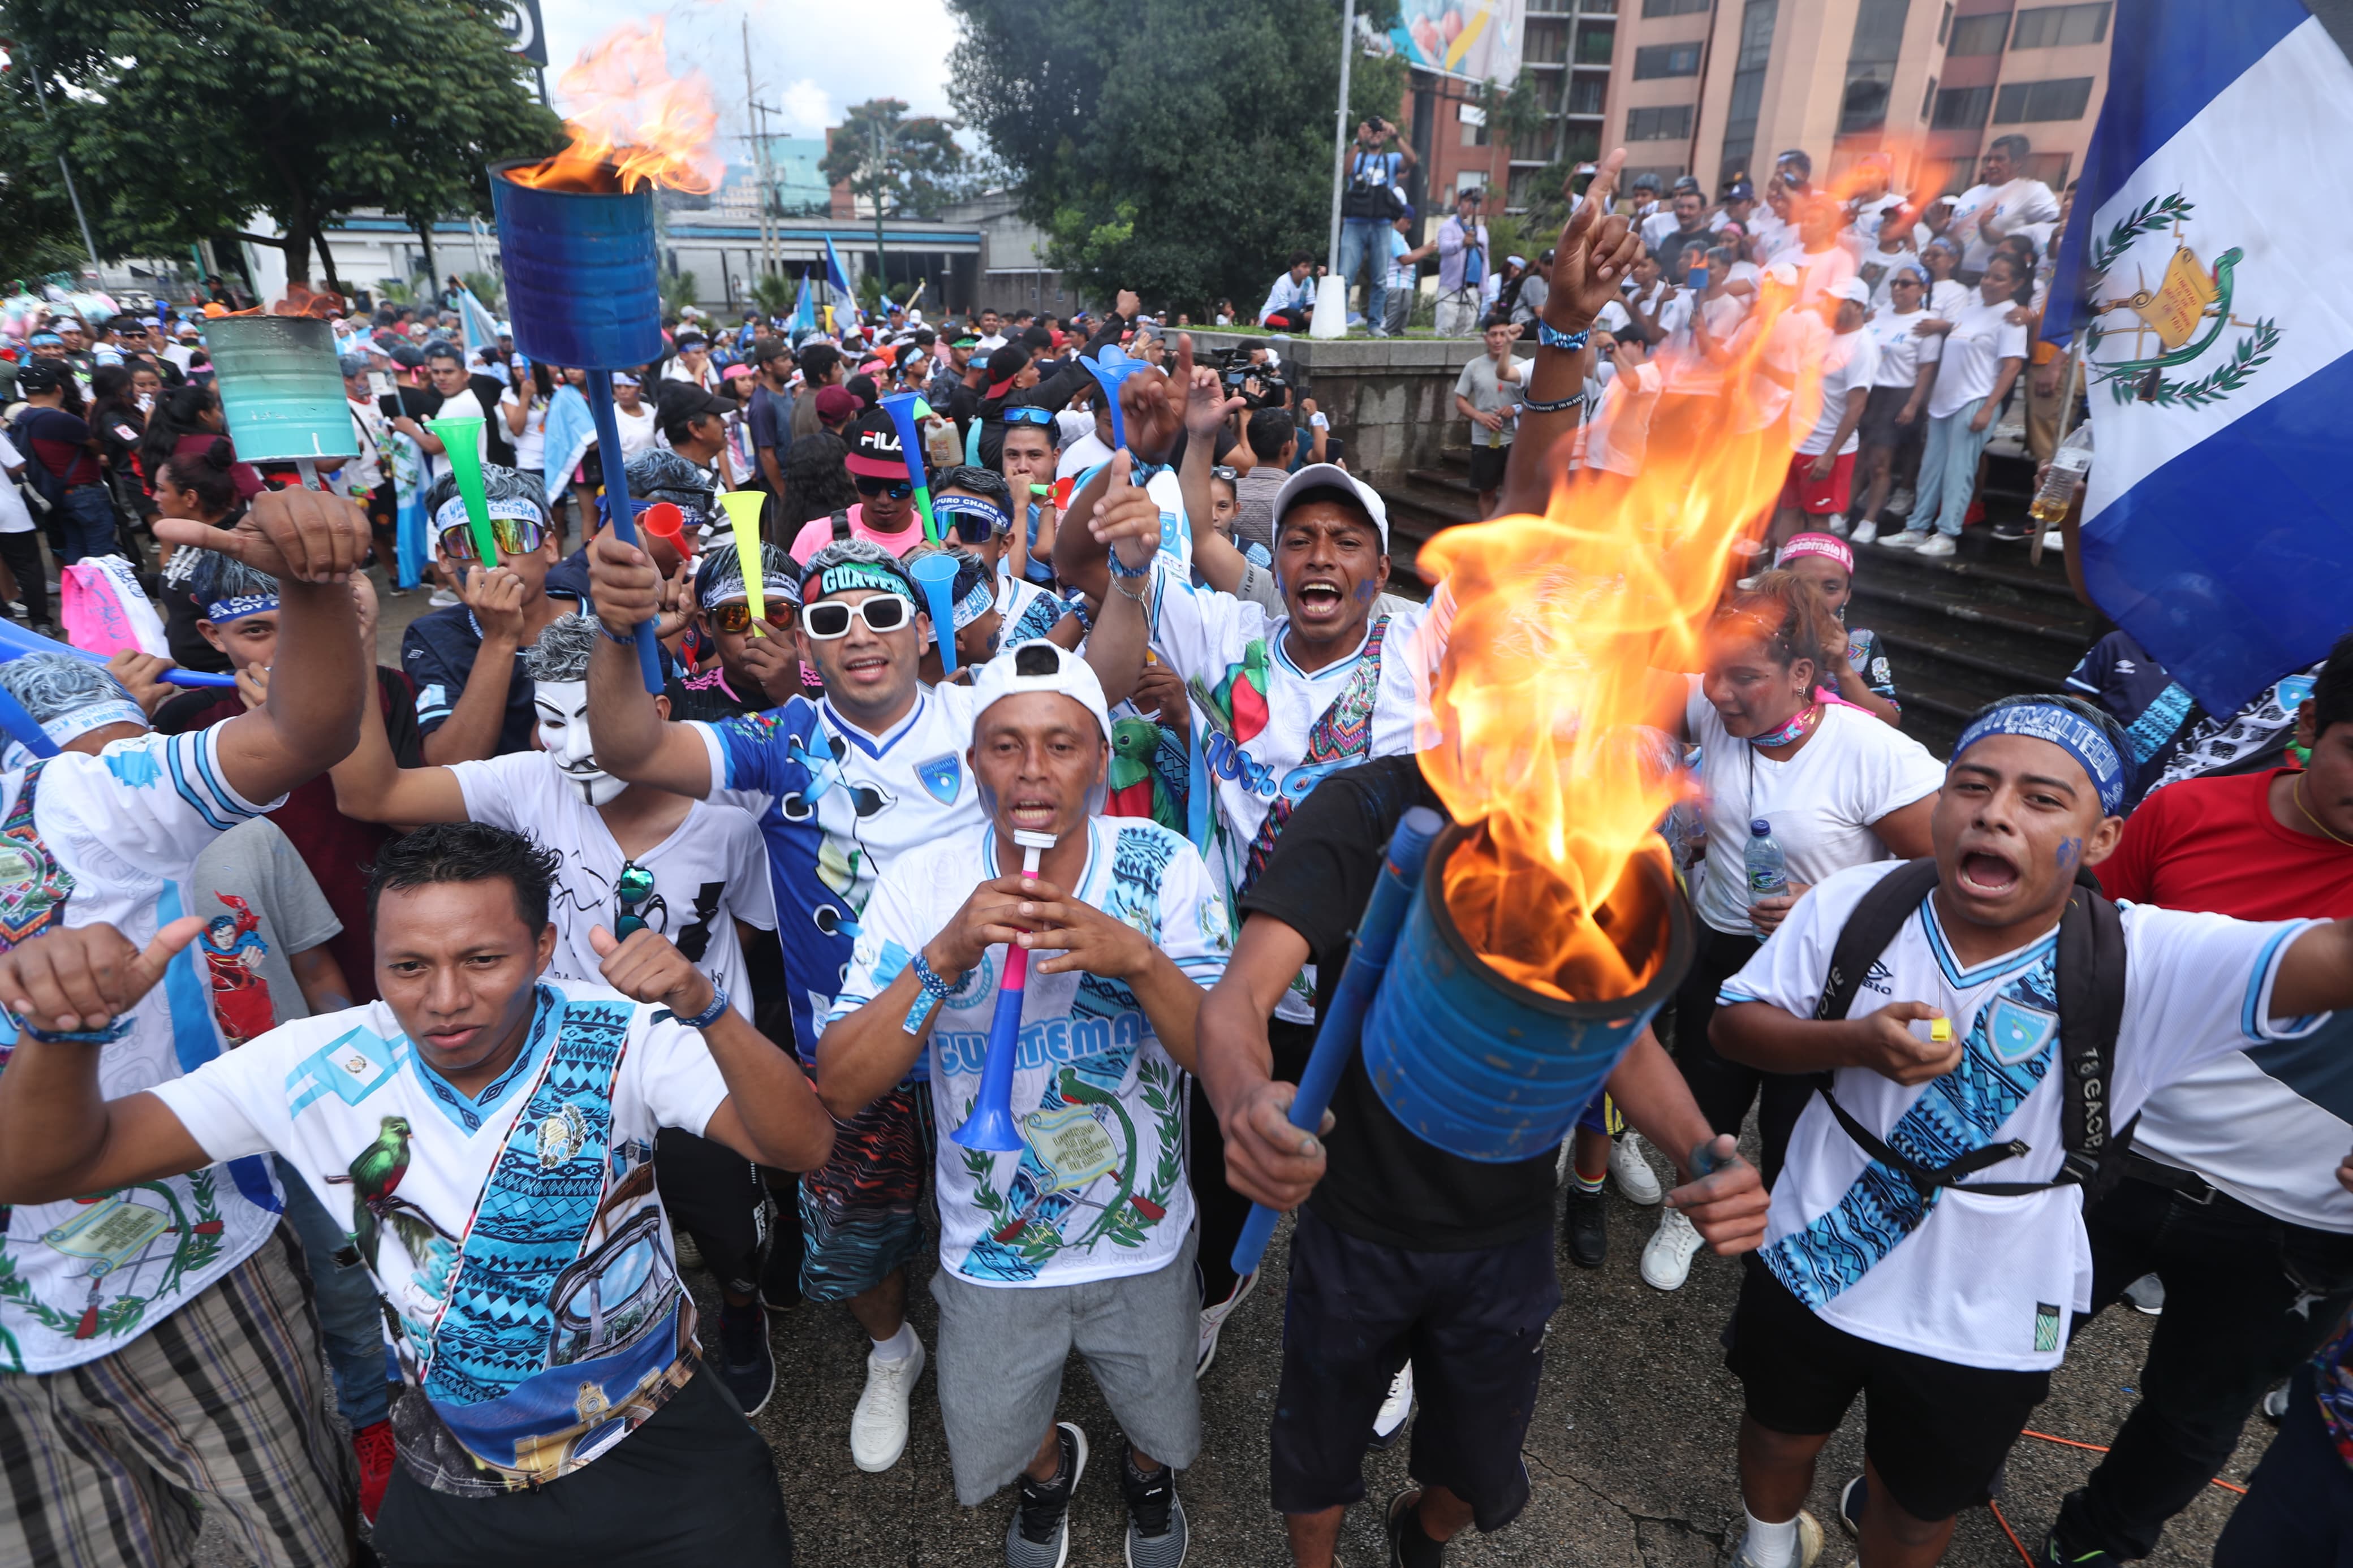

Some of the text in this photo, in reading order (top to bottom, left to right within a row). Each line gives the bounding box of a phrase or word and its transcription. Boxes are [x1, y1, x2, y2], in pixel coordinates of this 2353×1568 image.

[963, 499, 998, 515] CHAPIN
[231, 602, 265, 614] SOY
[1205, 729, 1277, 797] 100%
